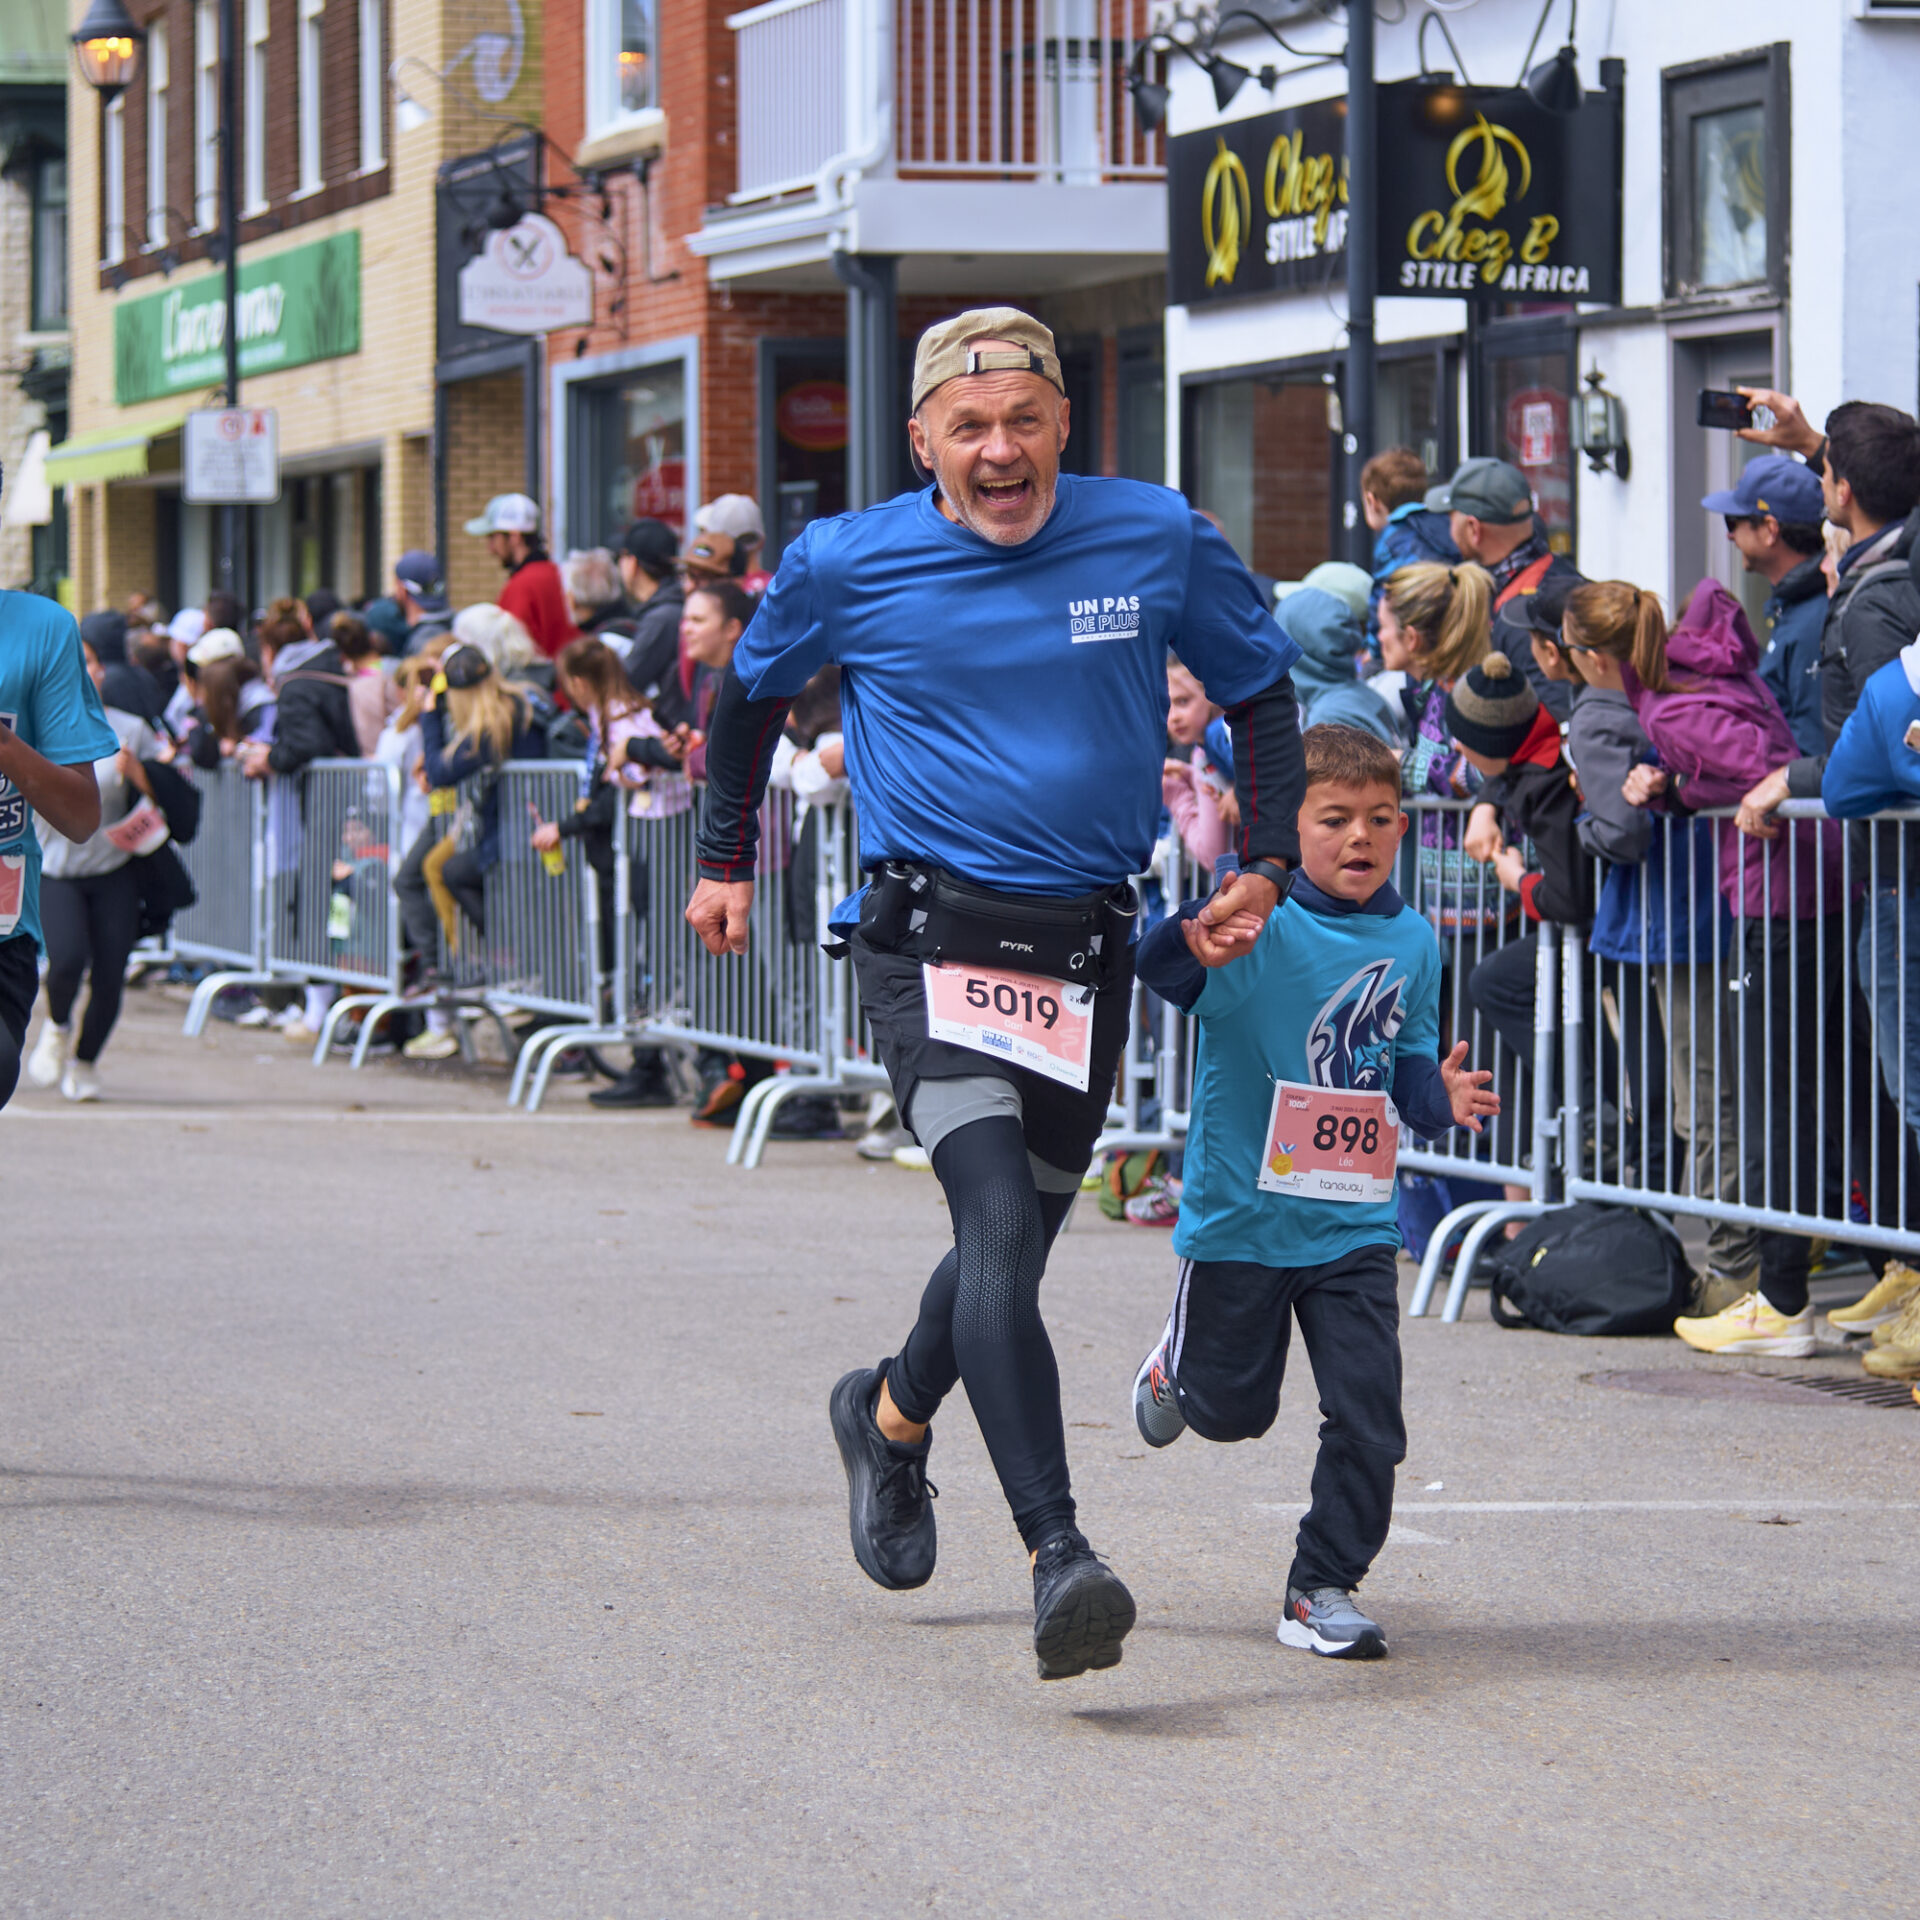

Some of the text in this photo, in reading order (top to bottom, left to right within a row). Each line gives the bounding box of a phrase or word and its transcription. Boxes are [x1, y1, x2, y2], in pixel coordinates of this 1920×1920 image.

[1264, 128, 1336, 244] Chez
[1265, 214, 1318, 265] STYLE
[1406, 207, 1514, 284] Chez
[1520, 214, 1560, 264] B
[1400, 260, 1590, 293] STYLE AFRICA
[1069, 595, 1140, 616] UN PAS
[1070, 612, 1140, 634] DE PLUS
[1000, 940, 1034, 953] PYFK
[966, 978, 1060, 1030] 5019
[1313, 1114, 1379, 1155] 898
[1338, 1156, 1354, 1167] Léo
[1319, 1178, 1364, 1196] tanguay
